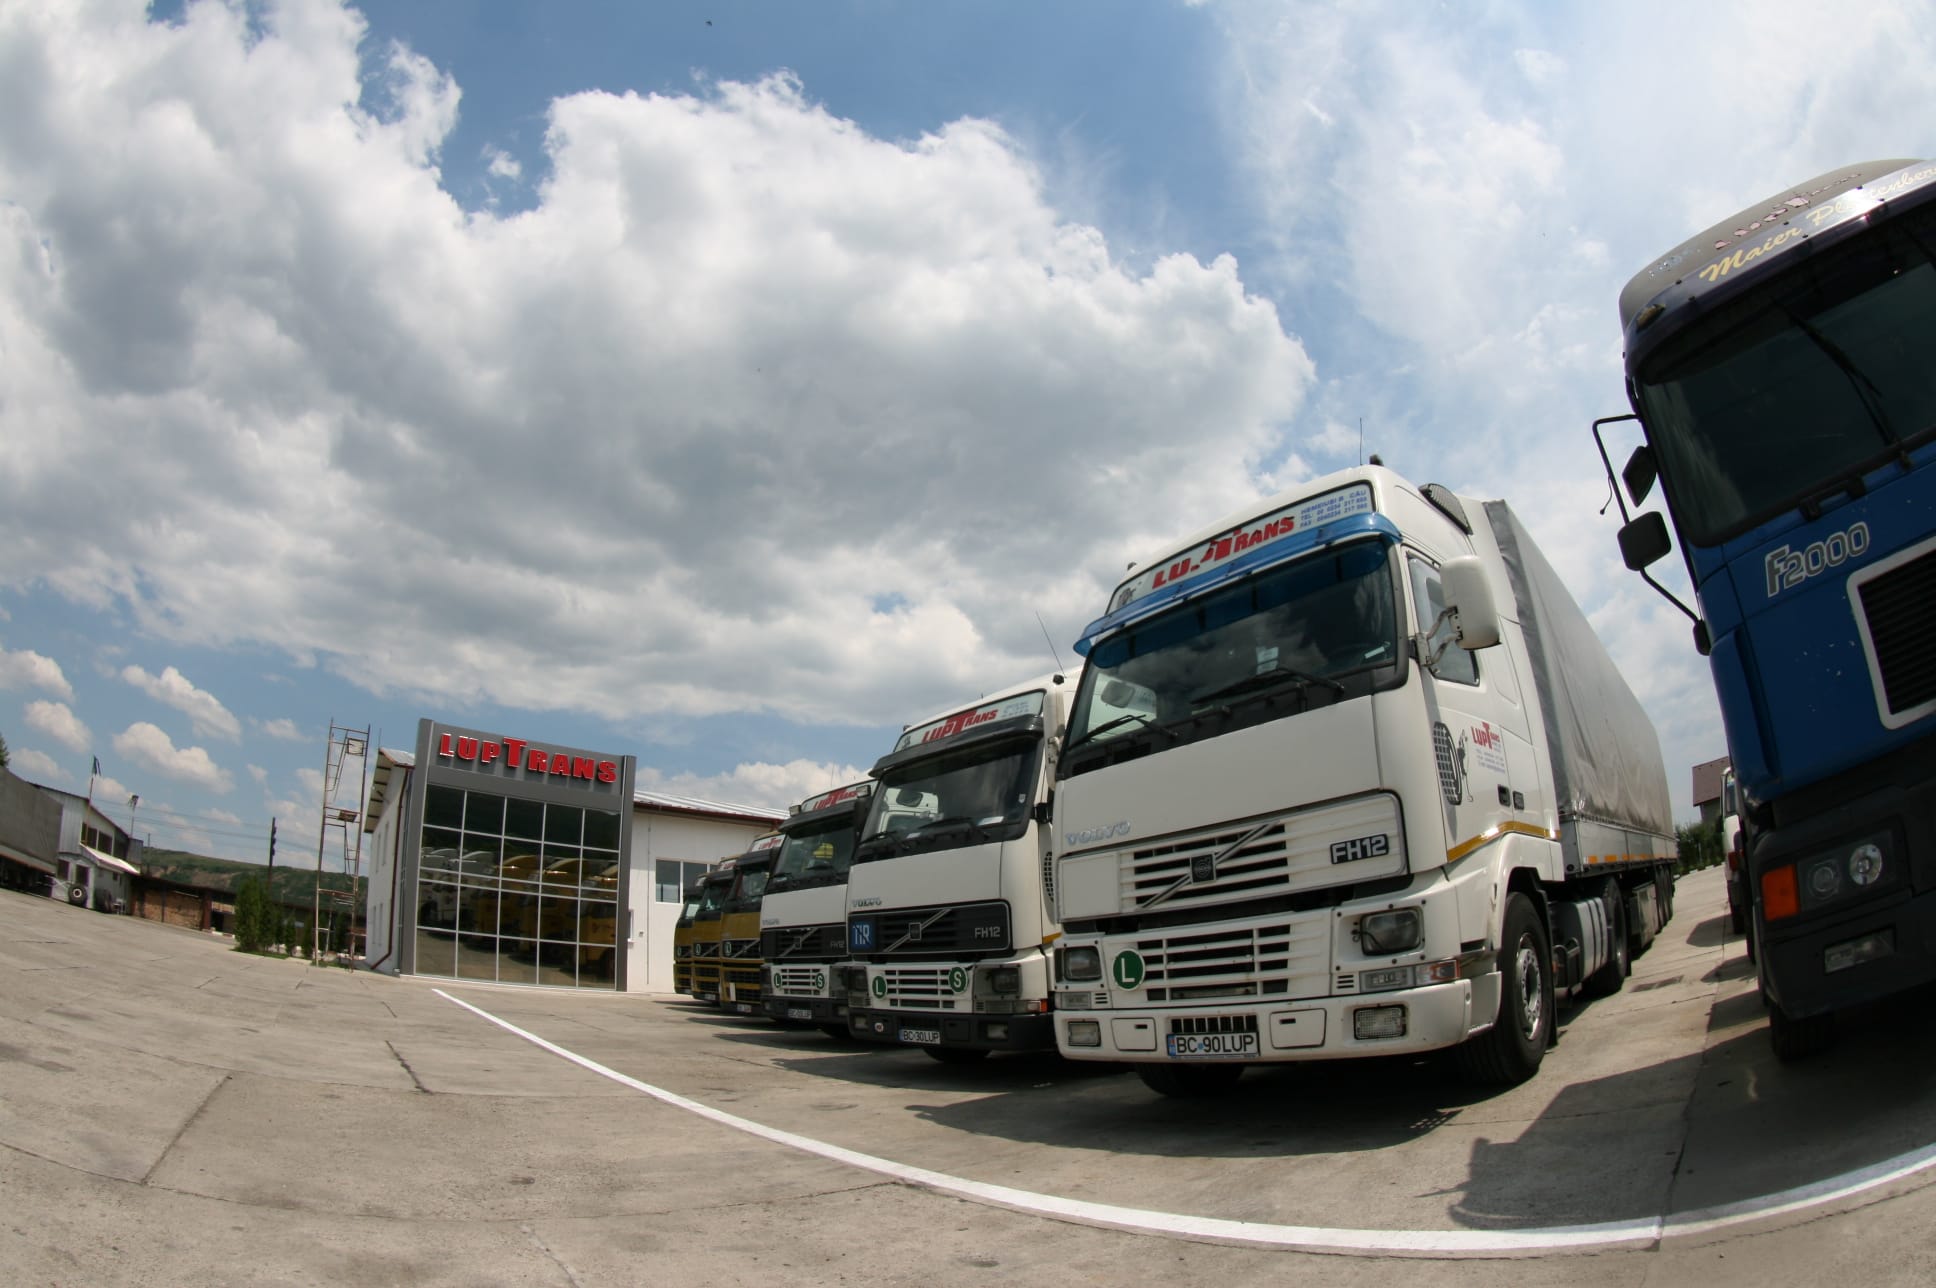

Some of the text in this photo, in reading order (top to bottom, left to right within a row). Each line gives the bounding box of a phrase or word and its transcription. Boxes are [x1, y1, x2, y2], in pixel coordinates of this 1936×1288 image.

[1699, 227, 1802, 282] Maier
[1764, 521, 1870, 598] F2000
[922, 709, 998, 743] LUPTRANS
[439, 733, 617, 783] LUPTRANS
[1065, 821, 1131, 845] VOLVO
[1332, 836, 1387, 863] FH12
[974, 926, 1001, 939] FH12
[954, 970, 962, 989] S
[1121, 957, 1136, 983] L
[875, 979, 884, 996] L
